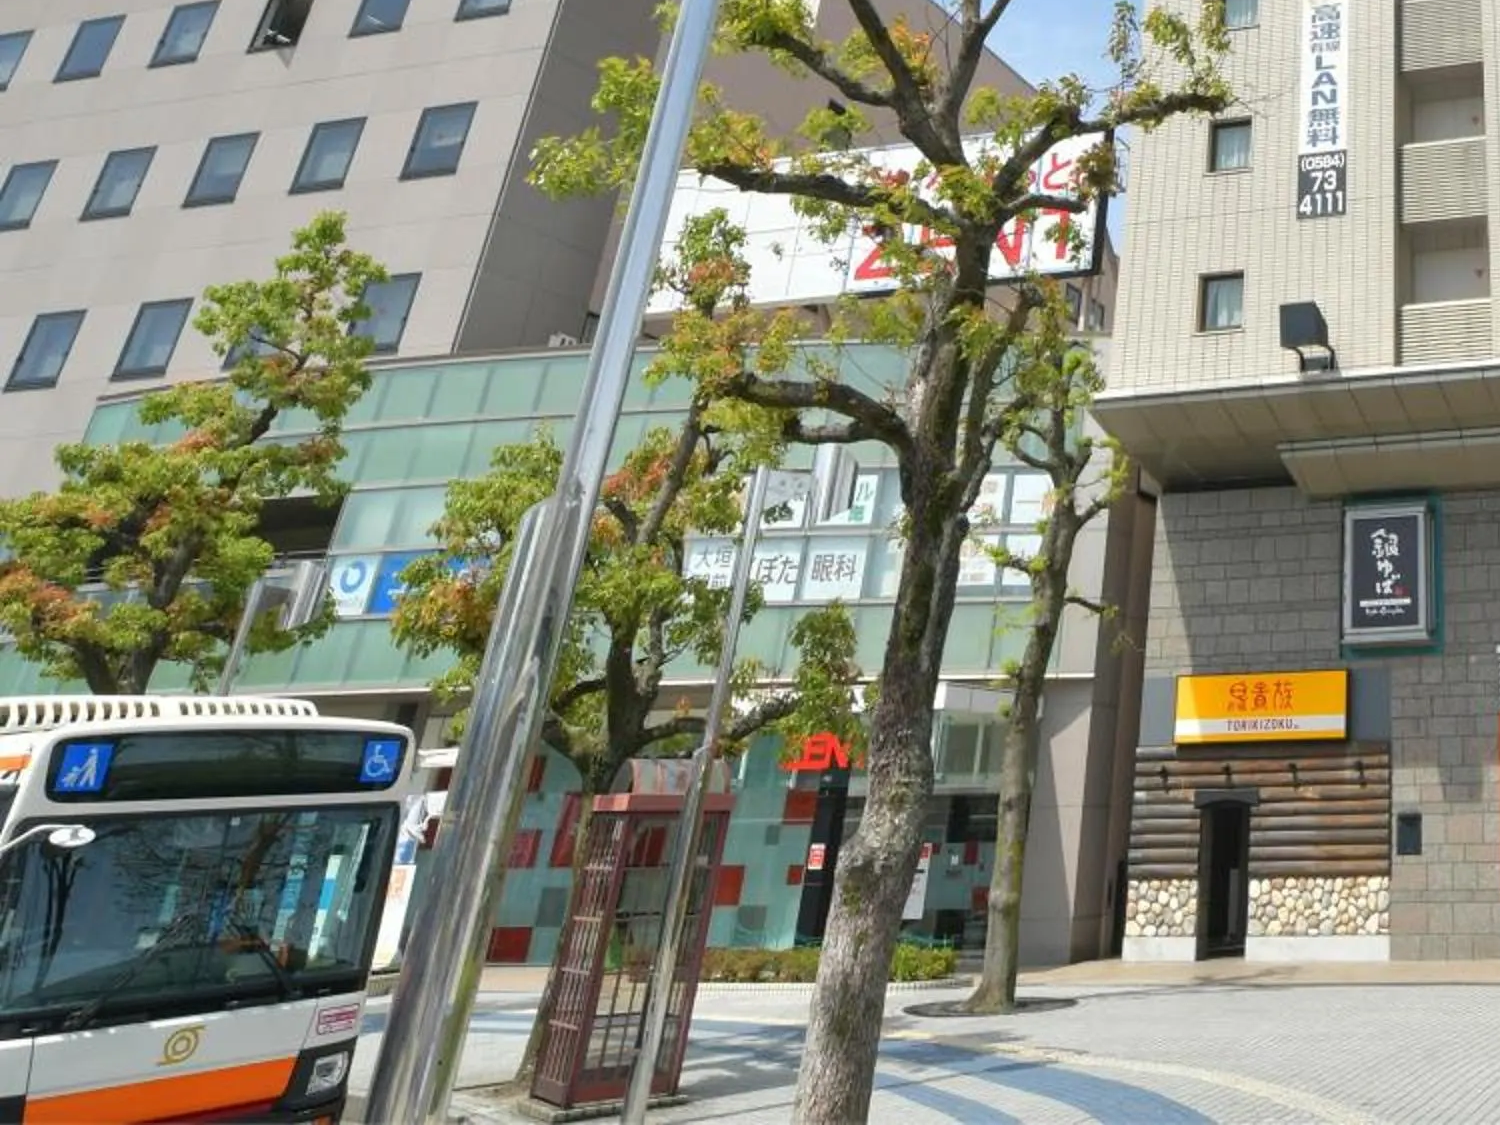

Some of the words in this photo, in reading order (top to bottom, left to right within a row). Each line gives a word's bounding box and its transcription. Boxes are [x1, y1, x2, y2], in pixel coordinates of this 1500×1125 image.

[1301, 152, 1345, 171] (0584)
[1310, 171, 1337, 193] 73
[1298, 191, 1344, 216] 4111
